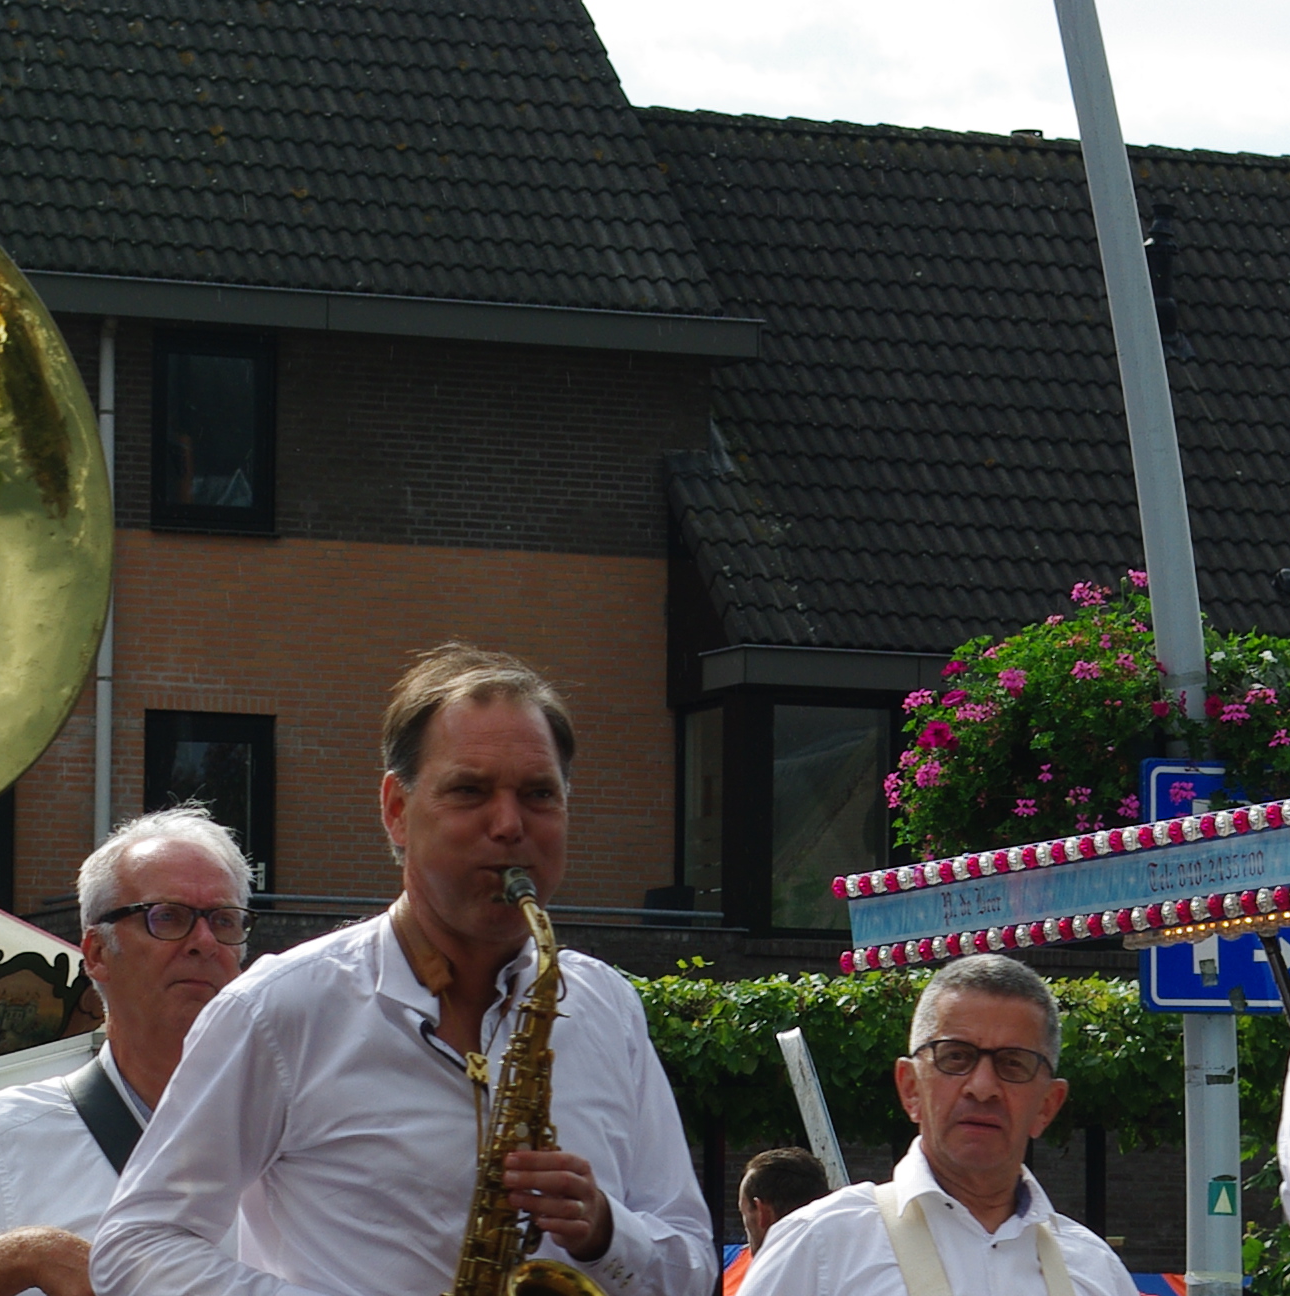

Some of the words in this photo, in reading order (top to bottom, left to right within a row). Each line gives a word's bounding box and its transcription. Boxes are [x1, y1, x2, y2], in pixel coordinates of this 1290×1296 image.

[1147, 861, 1174, 892] Tel:
[1177, 850, 1266, 888] 040-2435700
[959, 893, 972, 916] de
